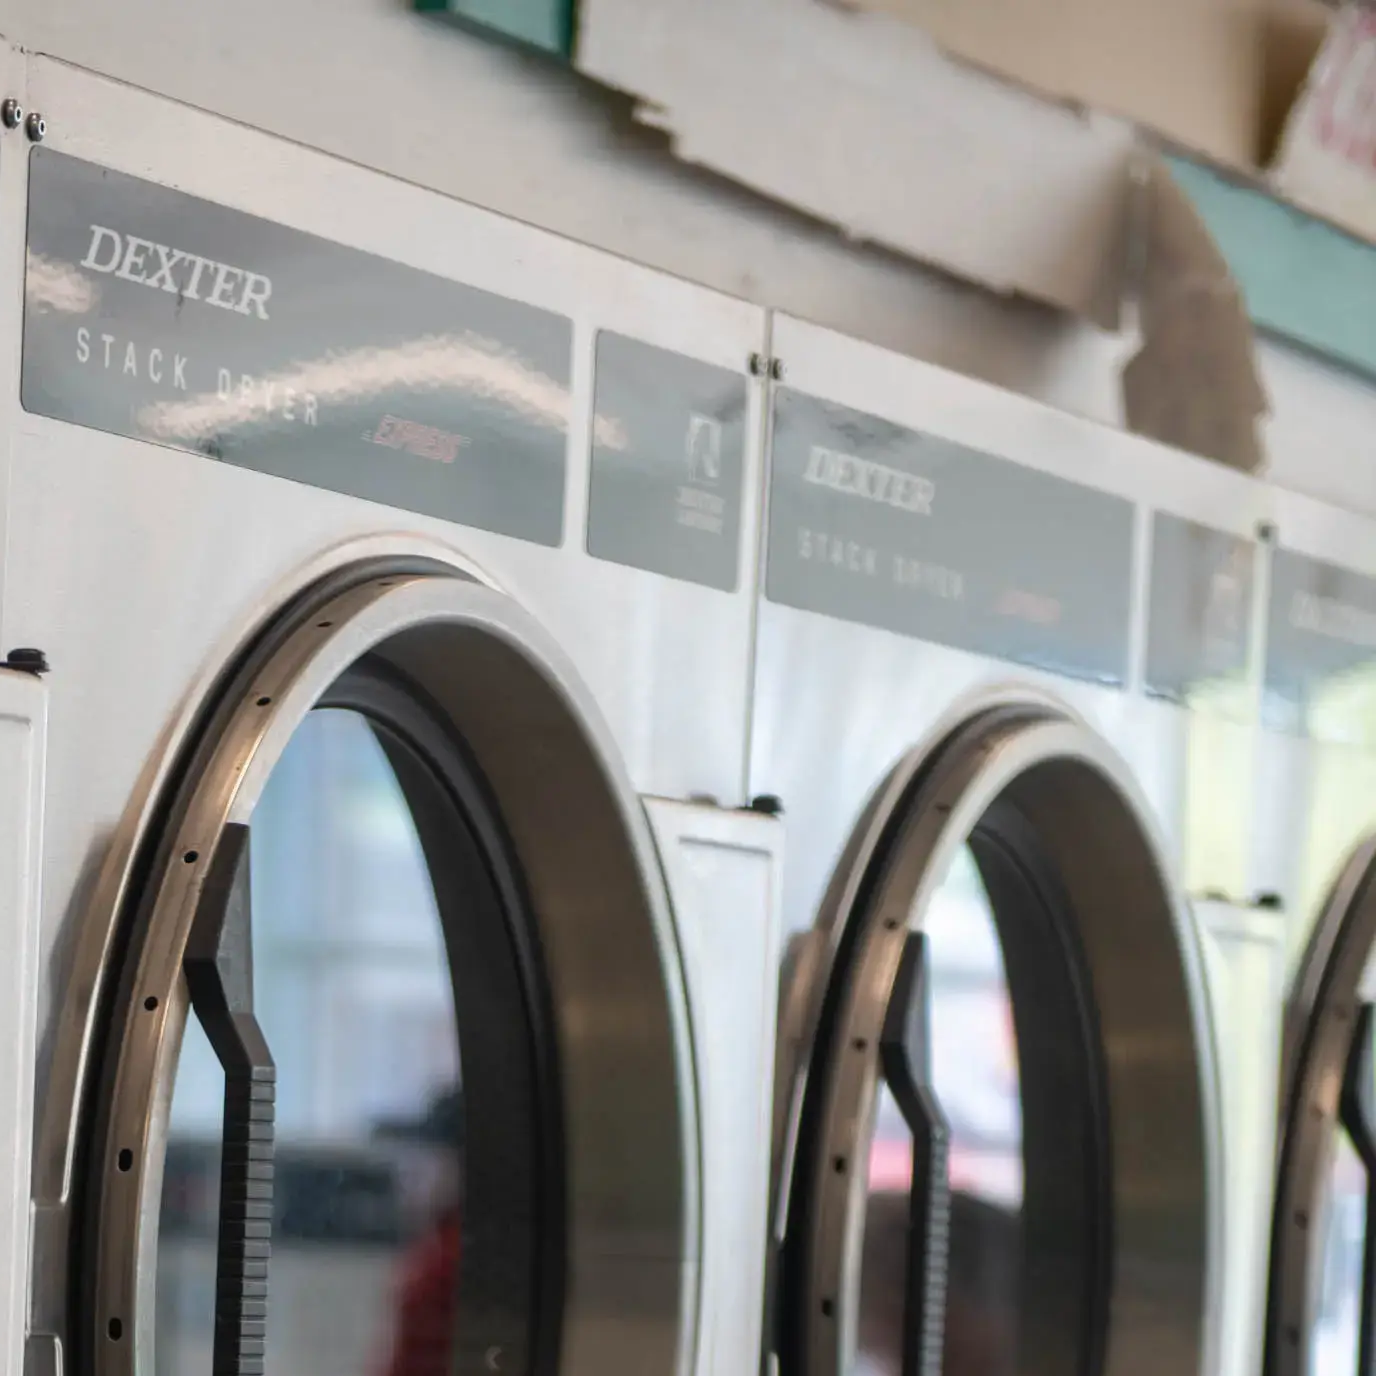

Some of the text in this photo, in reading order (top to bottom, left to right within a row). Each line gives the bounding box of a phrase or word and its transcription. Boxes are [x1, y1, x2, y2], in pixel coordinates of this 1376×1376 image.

[80, 224, 274, 320] DEXTER
[76, 327, 319, 426] STACK DRYER
[802, 445, 935, 516] DEXTER
